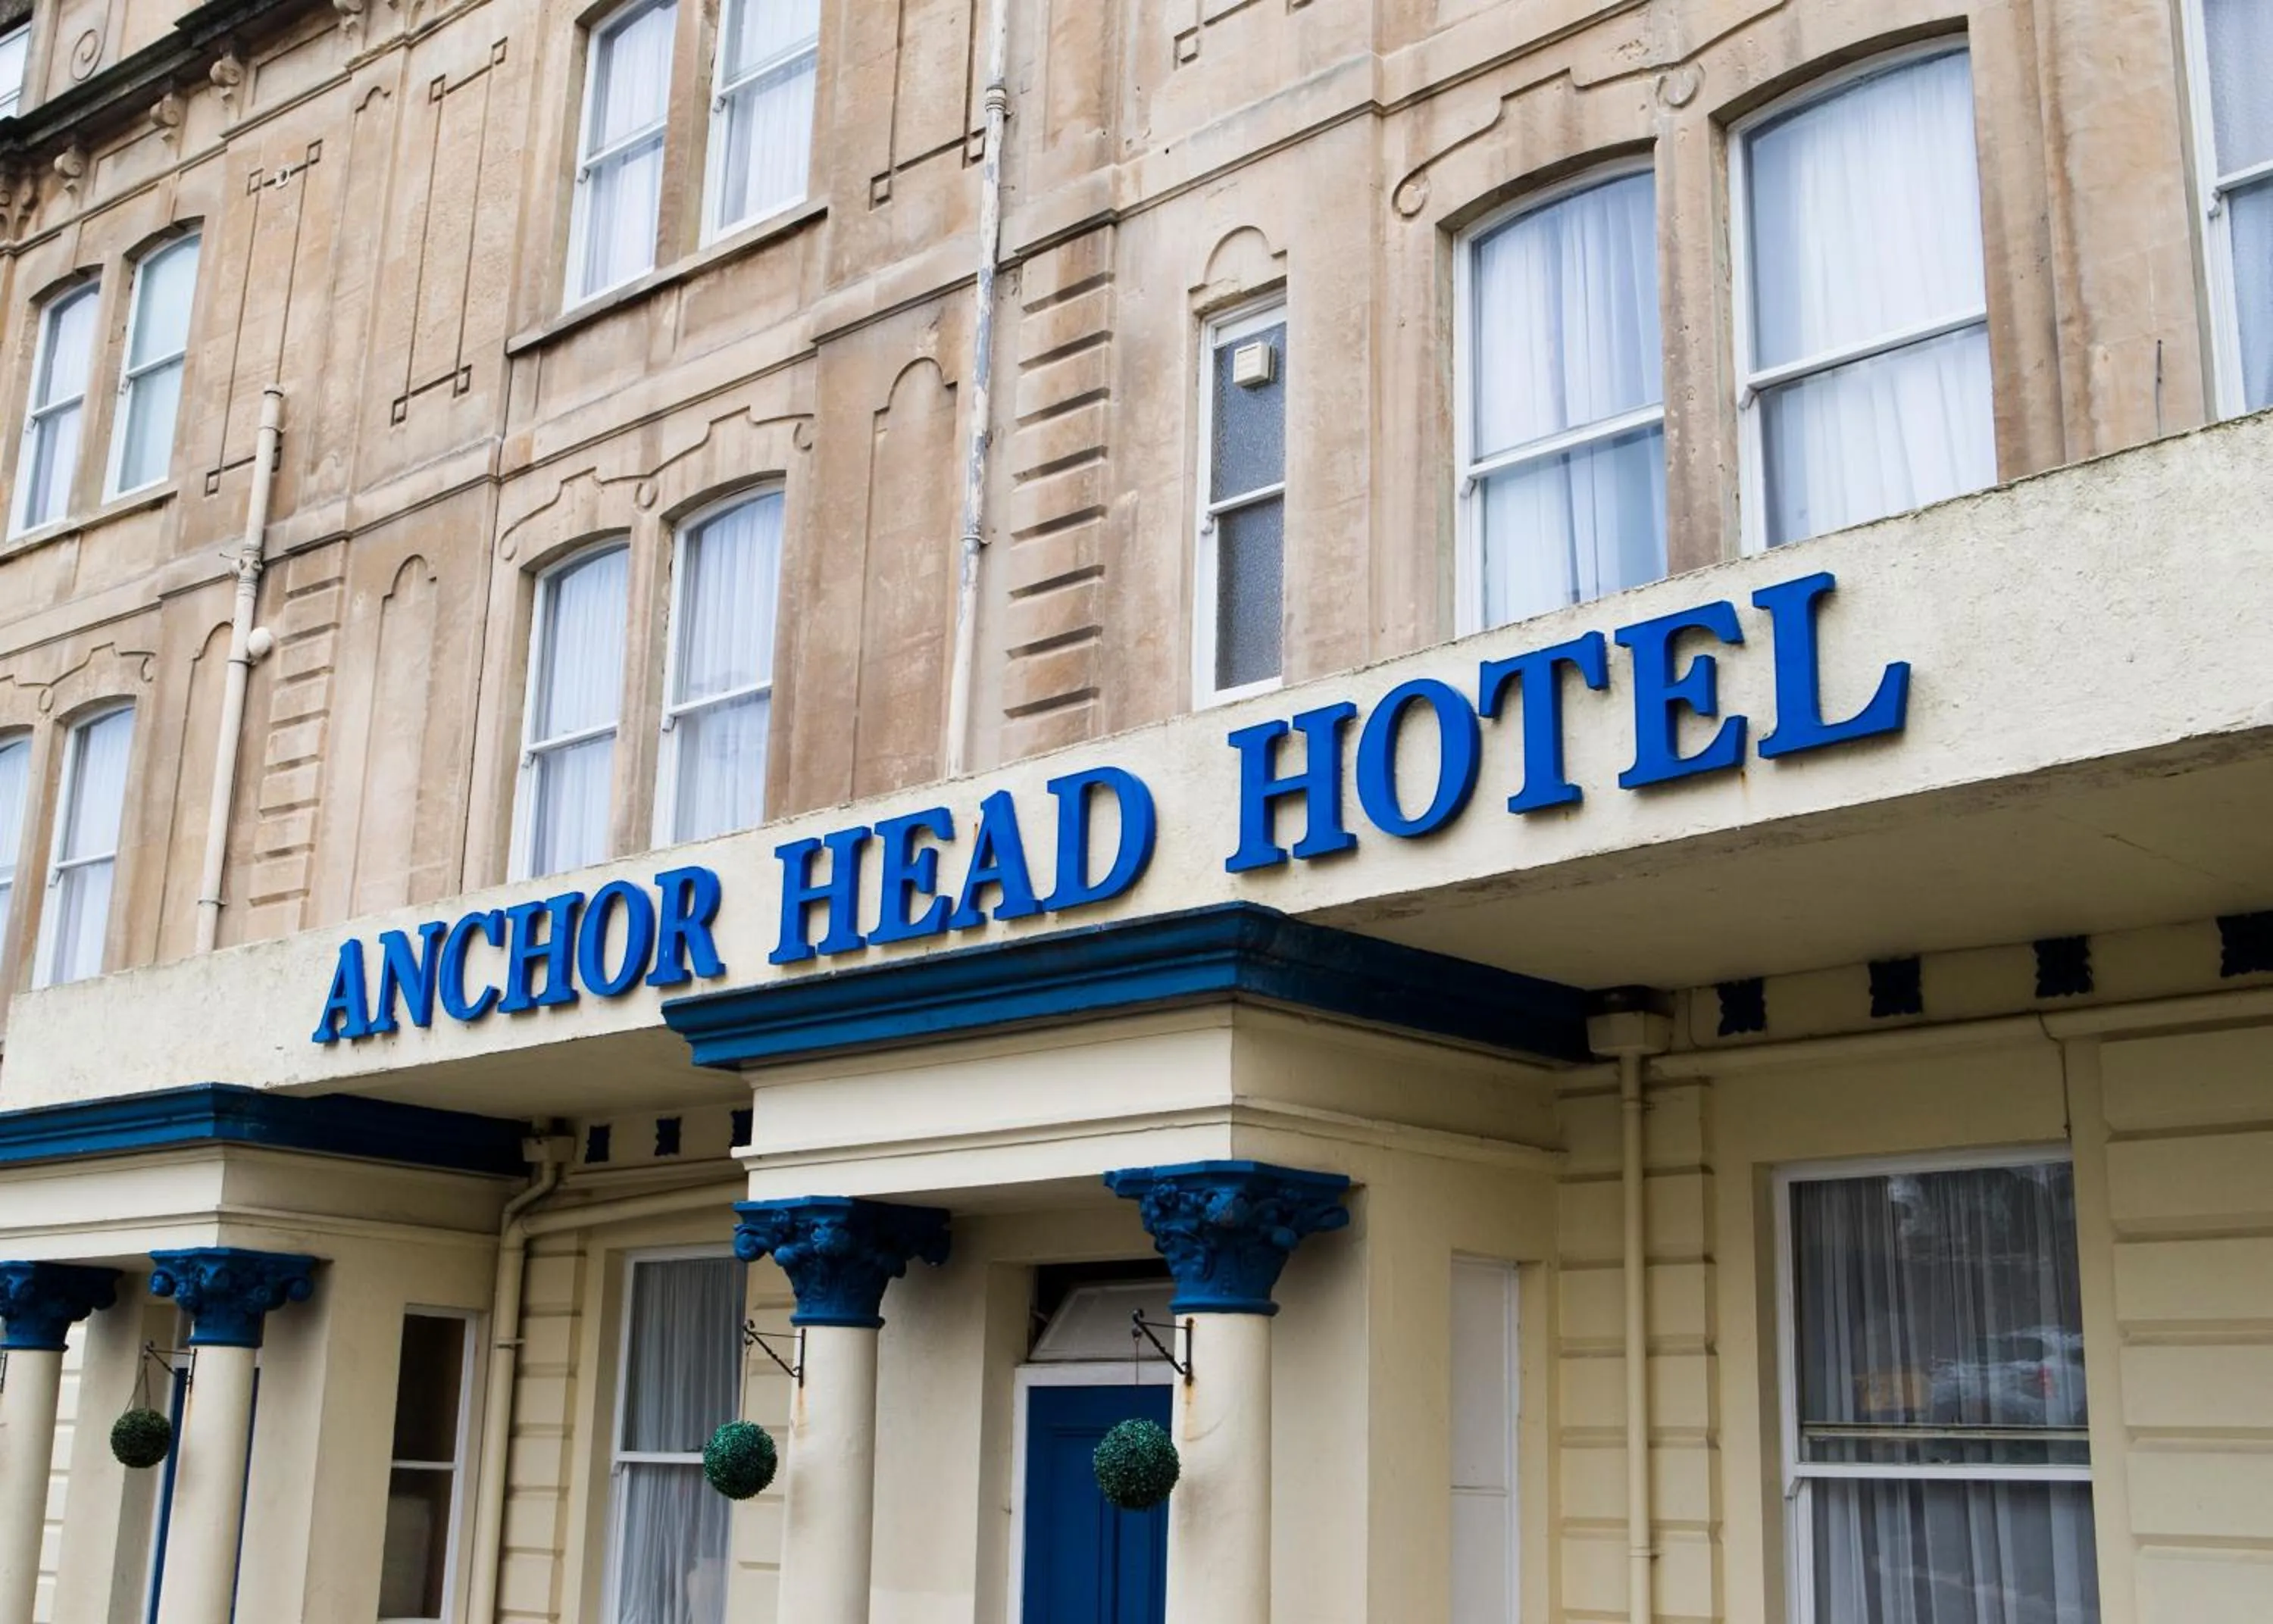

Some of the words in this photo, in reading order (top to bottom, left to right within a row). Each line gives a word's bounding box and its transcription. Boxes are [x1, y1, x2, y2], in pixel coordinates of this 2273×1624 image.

[312, 865, 726, 1044] ANCHOR
[768, 765, 1156, 965] HEAD
[1225, 572, 1910, 873] HOTEL
